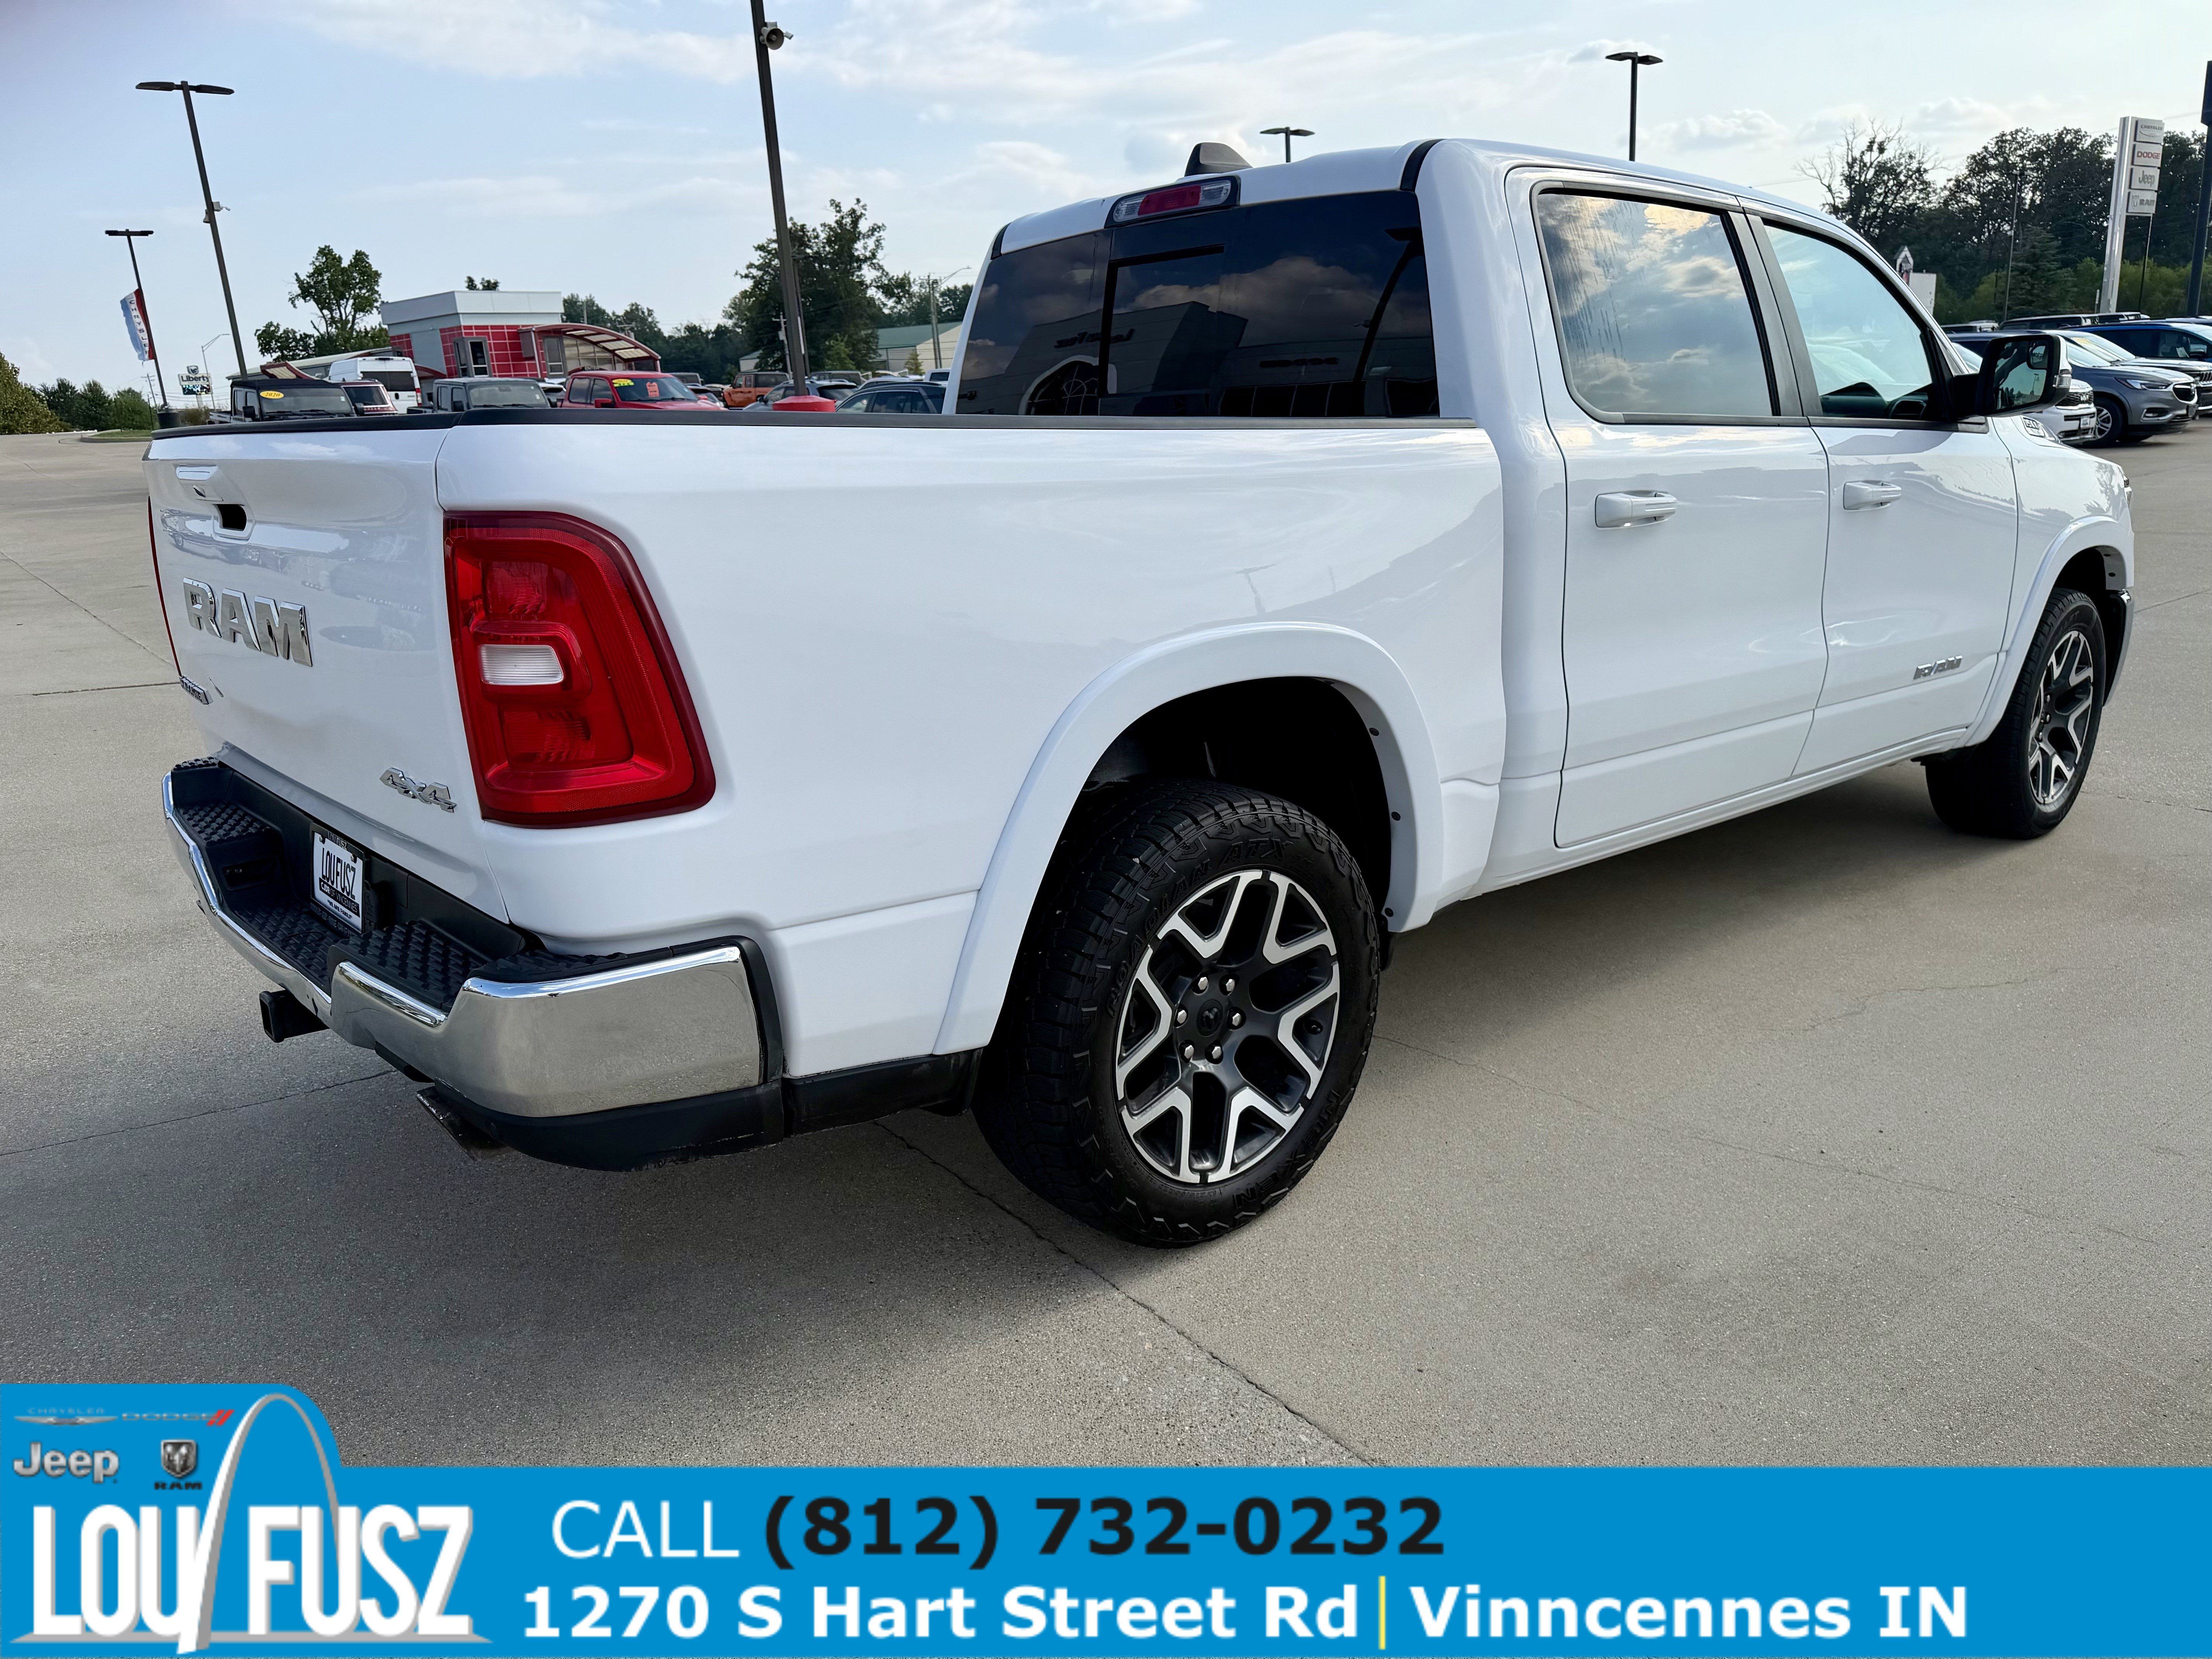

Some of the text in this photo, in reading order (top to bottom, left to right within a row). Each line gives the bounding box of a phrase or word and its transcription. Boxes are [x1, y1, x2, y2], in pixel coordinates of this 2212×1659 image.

[2137, 151, 2161, 159] DODGE
[2138, 170, 2155, 187] Jeep
[183, 577, 313, 667] RAM
[1913, 655, 1963, 680] RAM
[322, 847, 356, 900] LOU FUSZ
